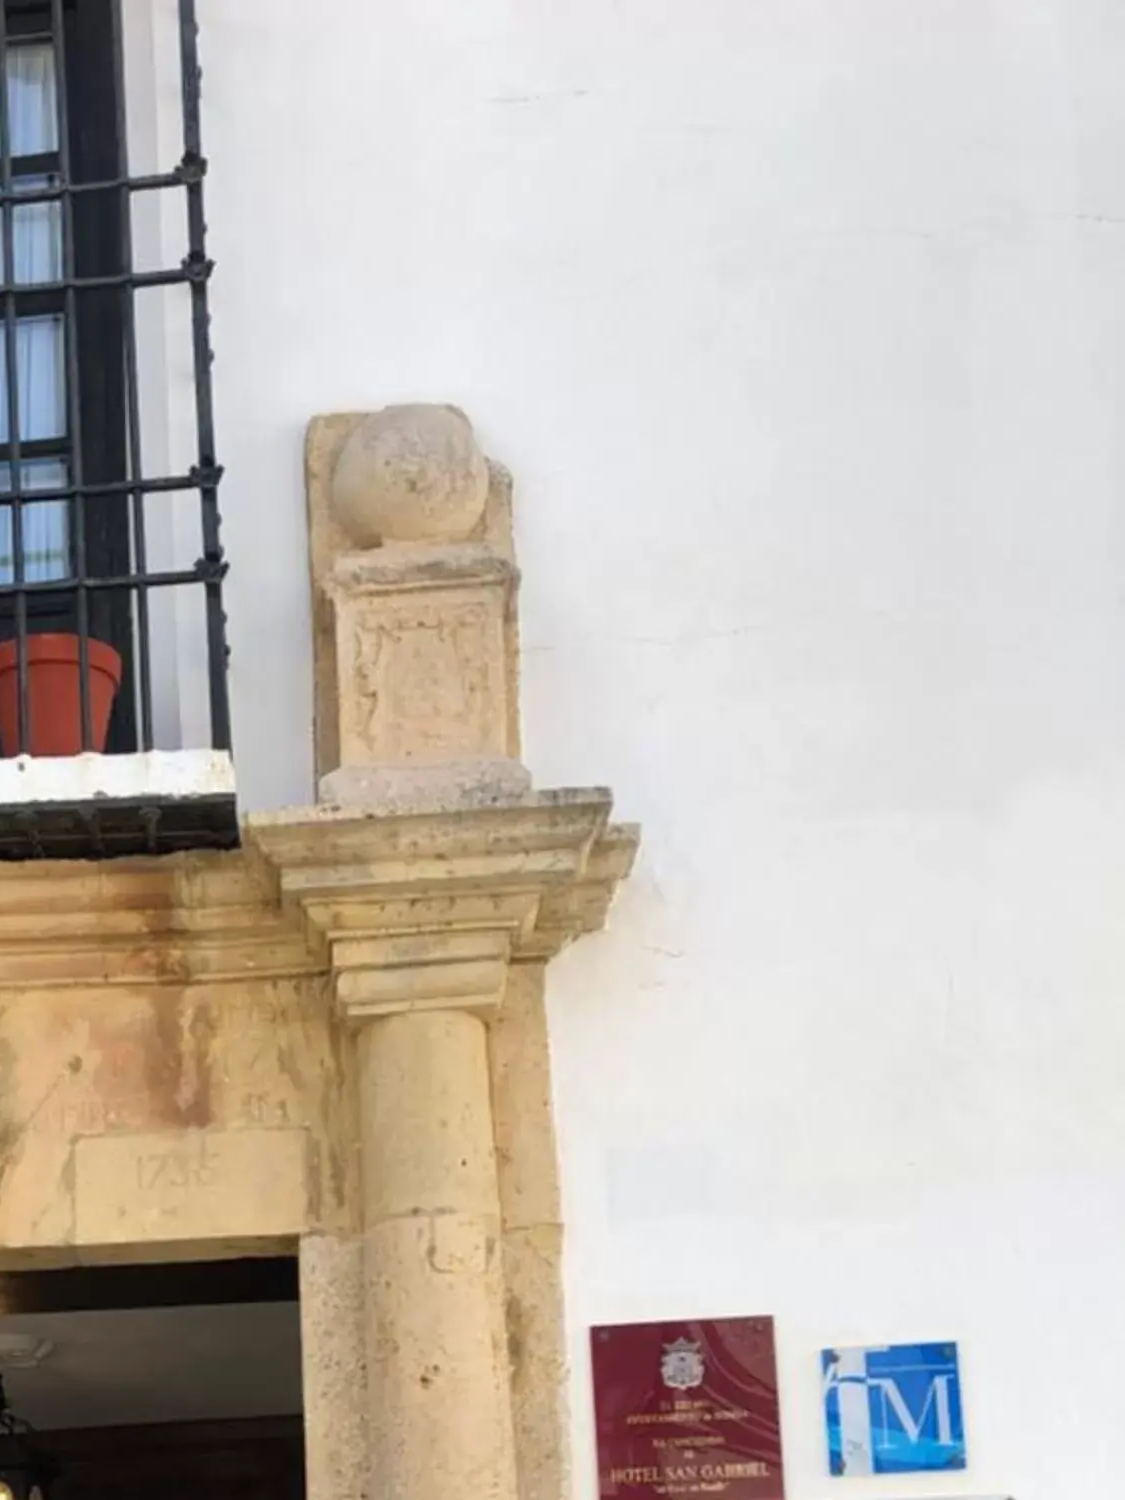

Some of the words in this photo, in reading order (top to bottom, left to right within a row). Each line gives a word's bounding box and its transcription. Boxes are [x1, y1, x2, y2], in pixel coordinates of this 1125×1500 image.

[610, 1466, 660, 1484] HOTEL
[665, 1464, 698, 1481] SAN
[700, 1461, 771, 1479] GABRIEL
